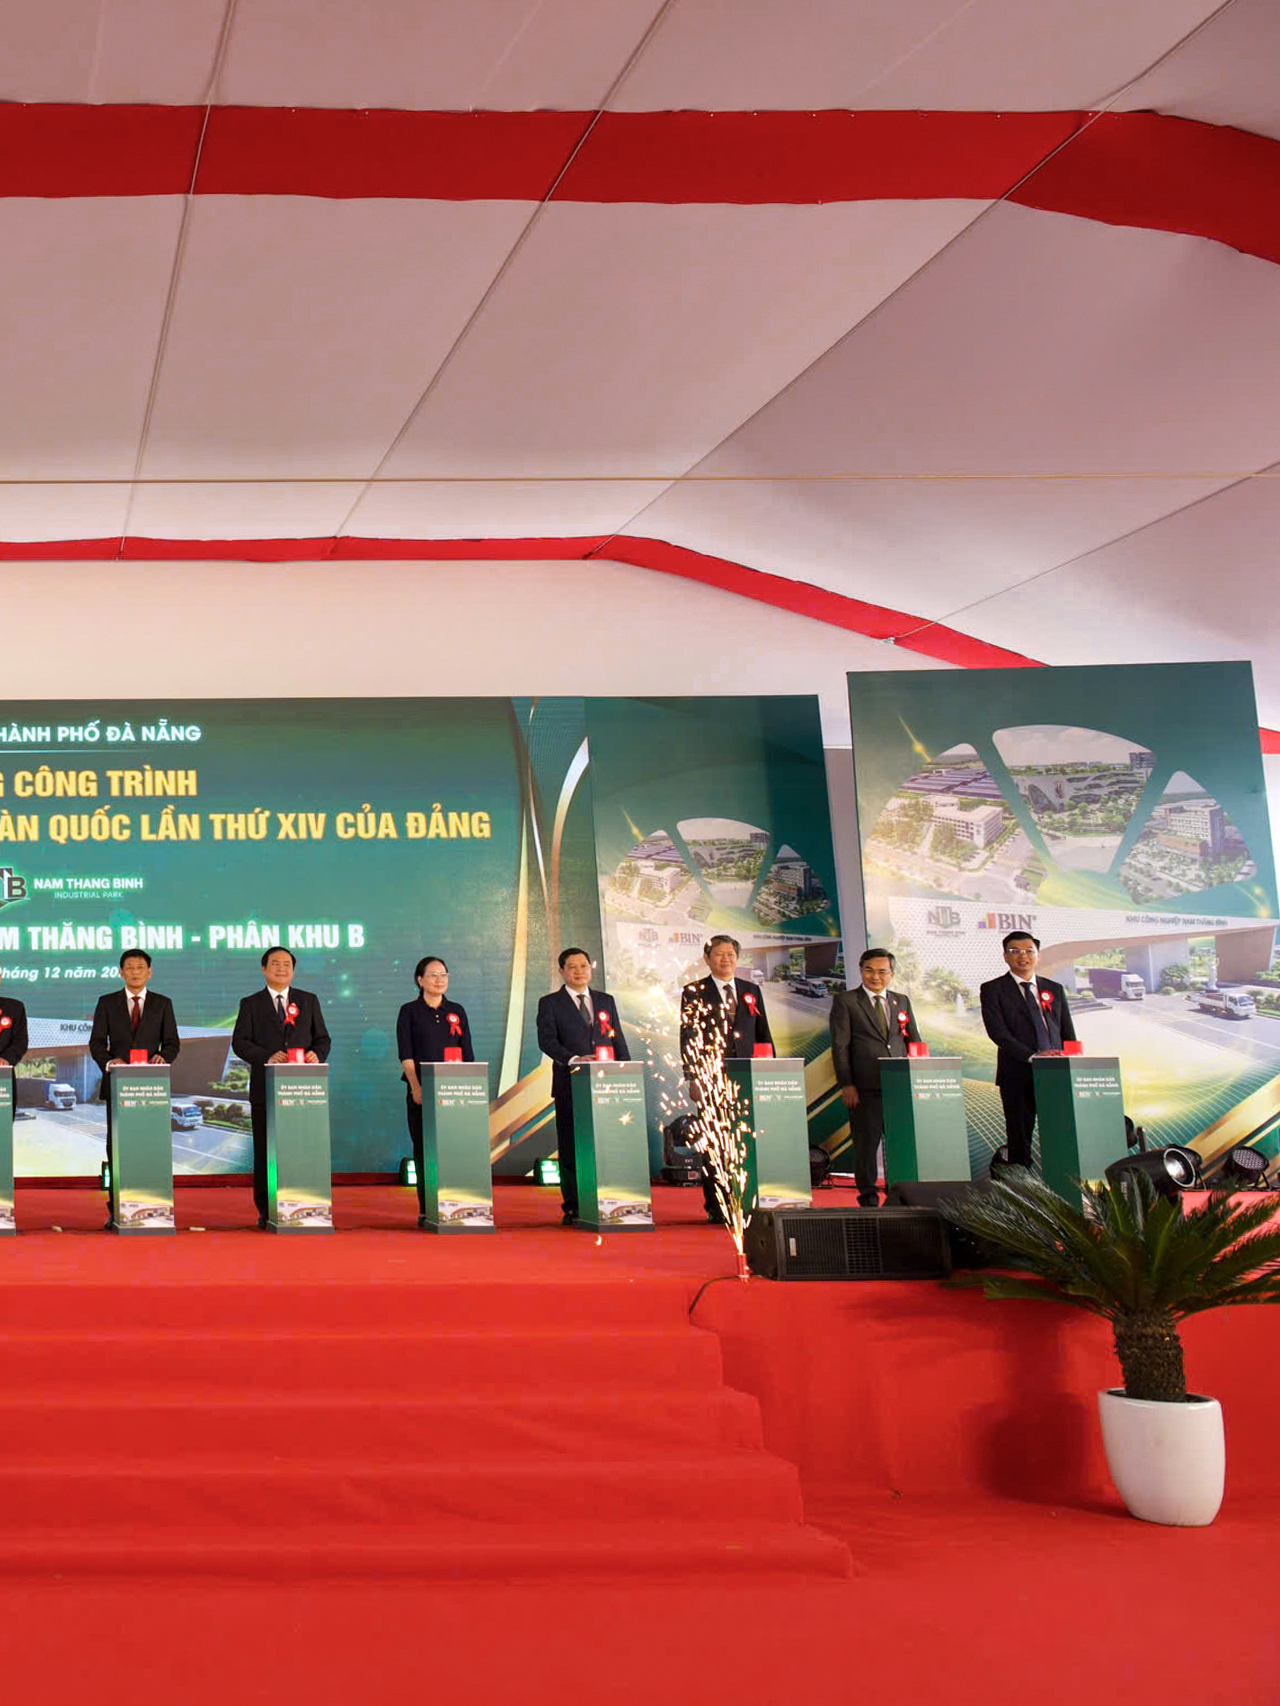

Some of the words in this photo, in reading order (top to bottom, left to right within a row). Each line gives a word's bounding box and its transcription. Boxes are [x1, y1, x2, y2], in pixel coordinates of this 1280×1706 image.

[57, 719, 100, 742] PHỐ
[106, 721, 136, 742] ĐÀ
[141, 718, 202, 742] NẴNG
[14, 765, 98, 798] CÔNG
[105, 764, 198, 797] TRÌNH
[48, 804, 131, 845] QUỐC
[140, 804, 201, 841] LẦN
[208, 806, 271, 841] THỨ
[277, 812, 327, 840] XIV
[335, 803, 398, 840] CỦA
[405, 802, 492, 839] ĐẢNG
[33, 877, 64, 889] NAM
[66, 877, 111, 889] THANG
[113, 877, 144, 889] BINH
[54, 891, 101, 899] INDUSTRIAL
[102, 891, 123, 899] PARK
[28, 921, 113, 951] THĂNG
[120, 921, 183, 950] BÌNH
[209, 920, 280, 950] PHÂN
[288, 924, 340, 949] KHU
[348, 924, 365, 949] B
[44, 966, 61, 978] 12
[64, 966, 96, 978] năm
